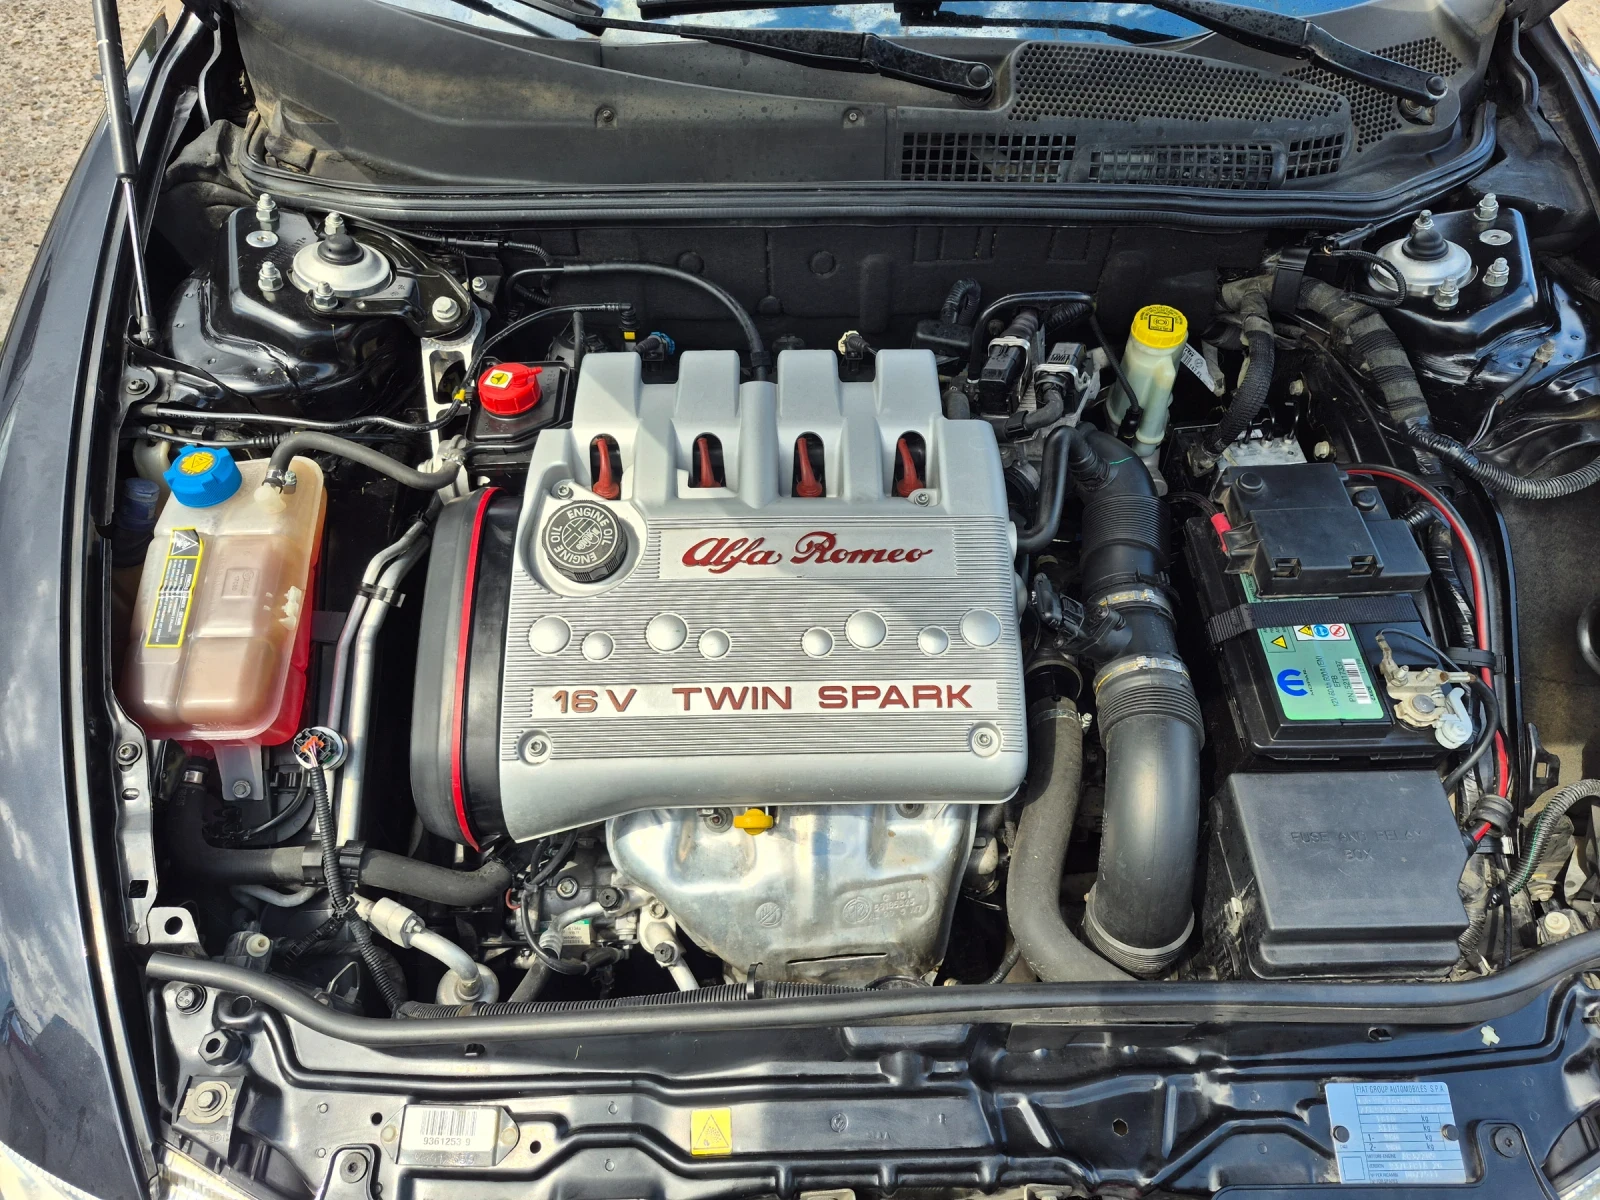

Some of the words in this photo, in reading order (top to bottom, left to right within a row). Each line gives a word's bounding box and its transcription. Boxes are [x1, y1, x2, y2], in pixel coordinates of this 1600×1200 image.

[550, 525, 563, 543] OIL
[566, 507, 610, 527] ENGINE
[601, 528, 613, 546] OIL
[553, 544, 598, 564] ENGINE
[681, 537, 783, 574] Alfa
[790, 531, 933, 565] Romeo
[1330, 674, 1341, 688] EFB
[672, 685, 793, 712] TWIN
[818, 684, 973, 710] SPARK
[1290, 831, 1329, 843] FUSE
[1338, 831, 1367, 842] AND
[1343, 848, 1374, 860] BOX
[1355, 1085, 1370, 1093] FIAT
[1370, 1085, 1388, 1093] GROUP
[1389, 1085, 1428, 1093] AUTOMOBILES
[465, 1138, 471, 1146] 9
